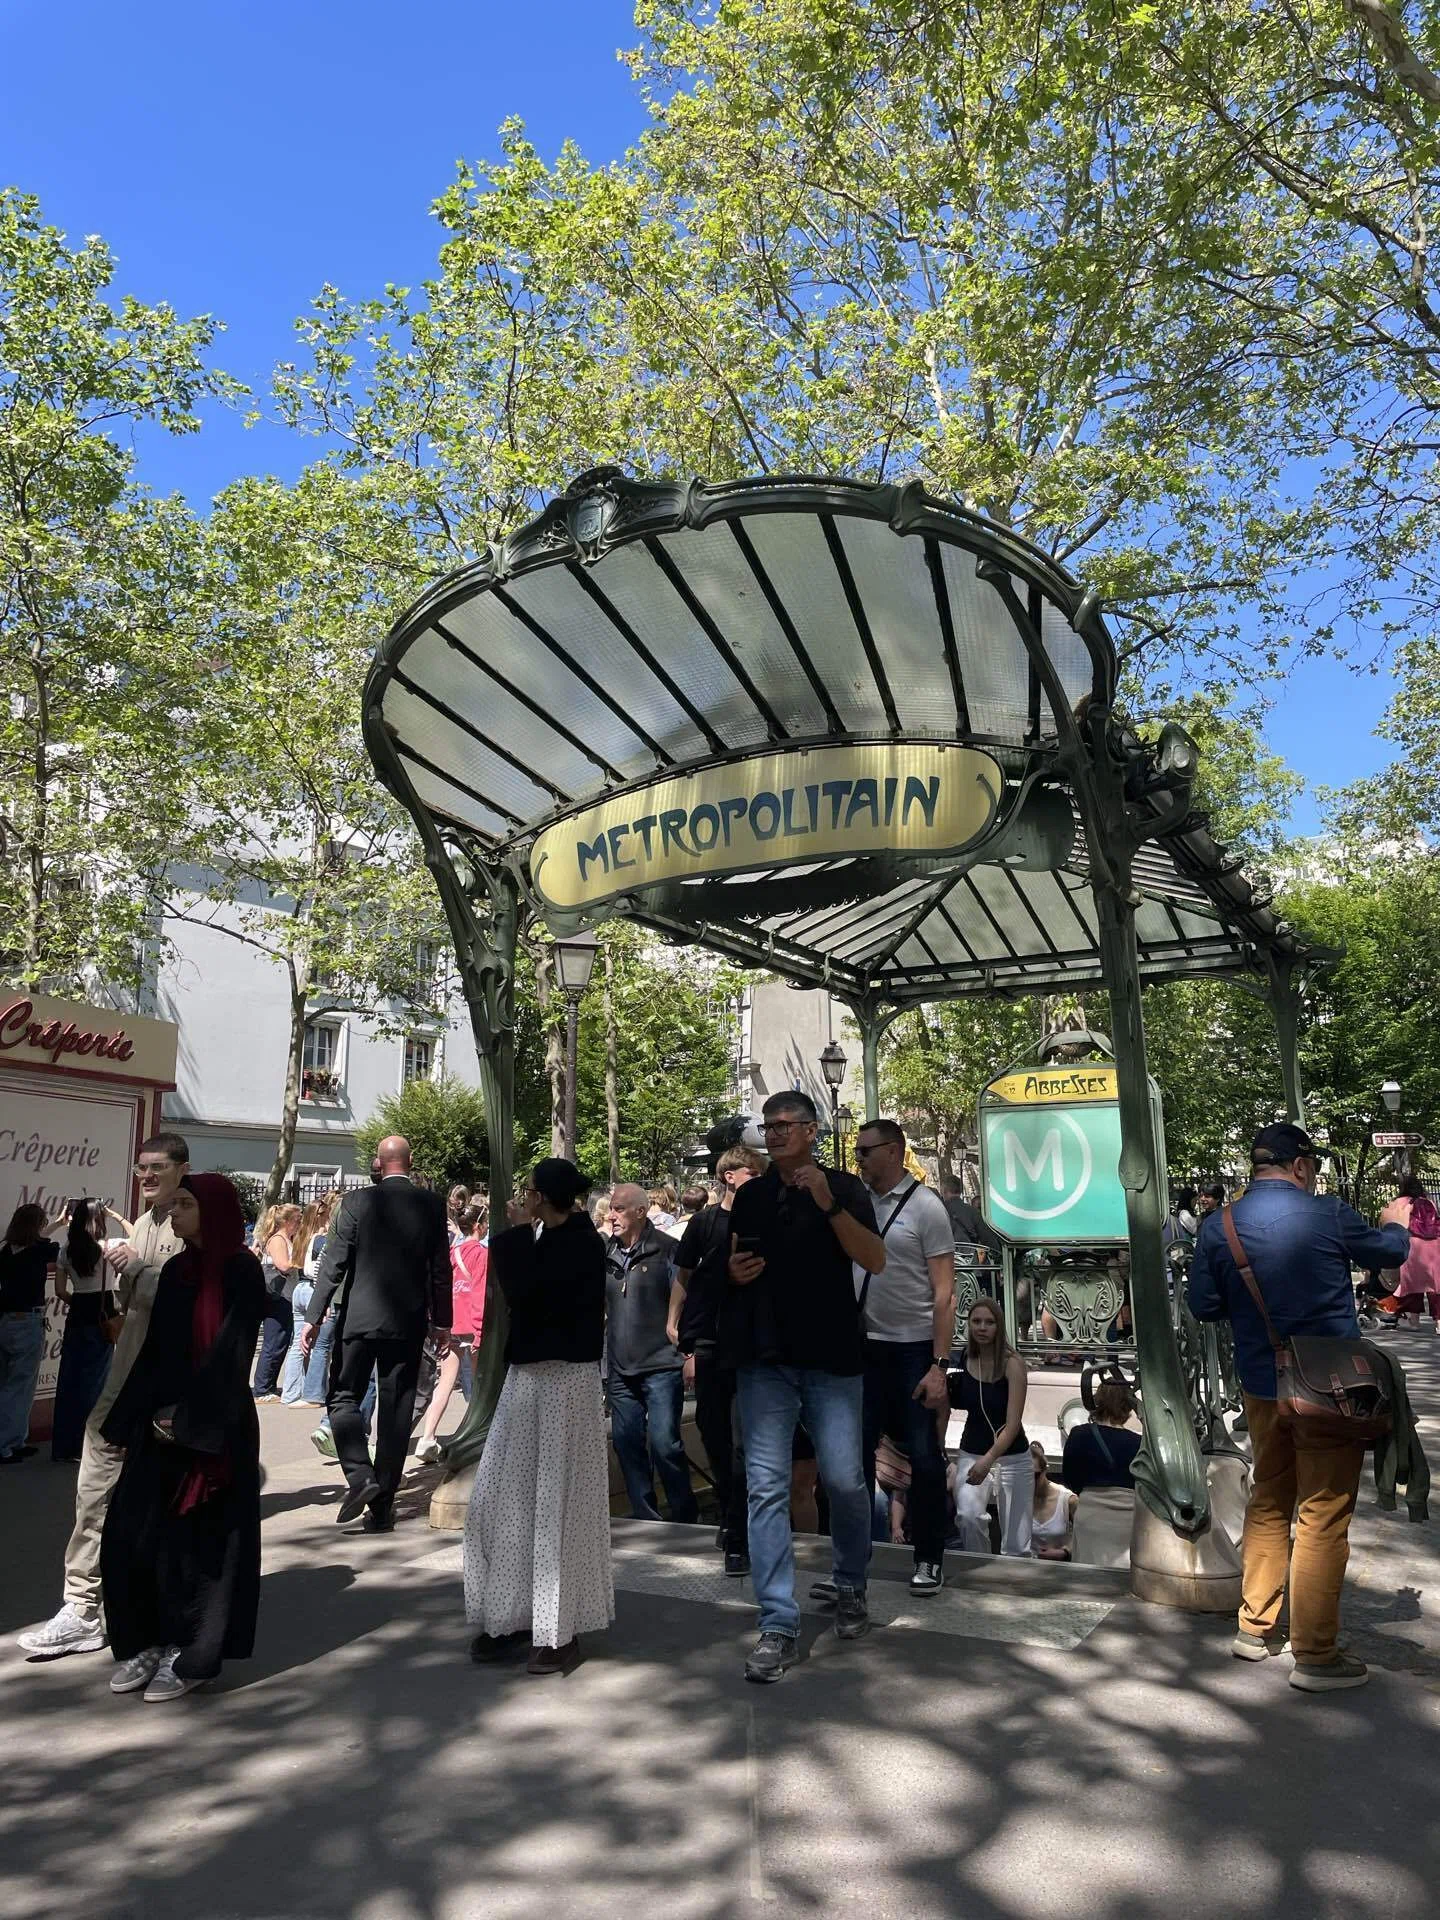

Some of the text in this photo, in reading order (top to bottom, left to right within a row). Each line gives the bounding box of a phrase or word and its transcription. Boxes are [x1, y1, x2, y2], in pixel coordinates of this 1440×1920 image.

[577, 776, 940, 881] METROPOLITAIN
[0, 1000, 134, 1062] Crêperie
[0, 1129, 100, 1172] Crêperie
[1004, 1128, 1064, 1192] M
